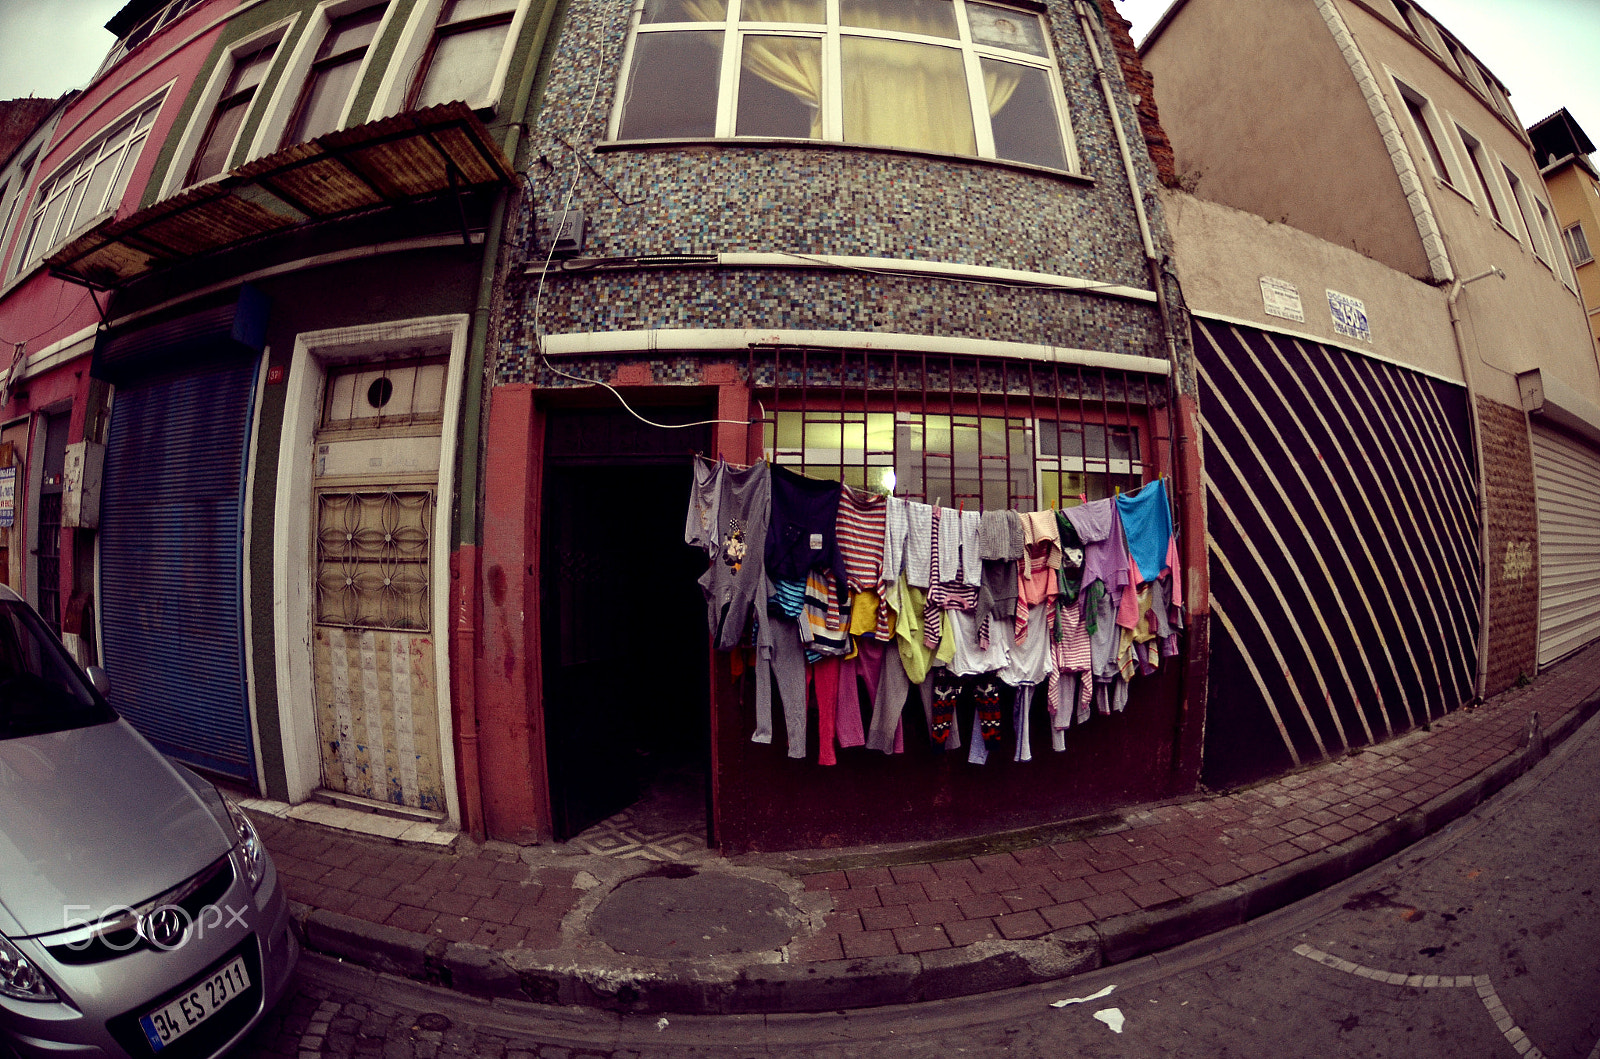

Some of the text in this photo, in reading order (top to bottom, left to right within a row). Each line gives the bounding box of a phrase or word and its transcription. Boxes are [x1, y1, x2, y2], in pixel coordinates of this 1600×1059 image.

[153, 963, 245, 1041] 34 ES 2311
